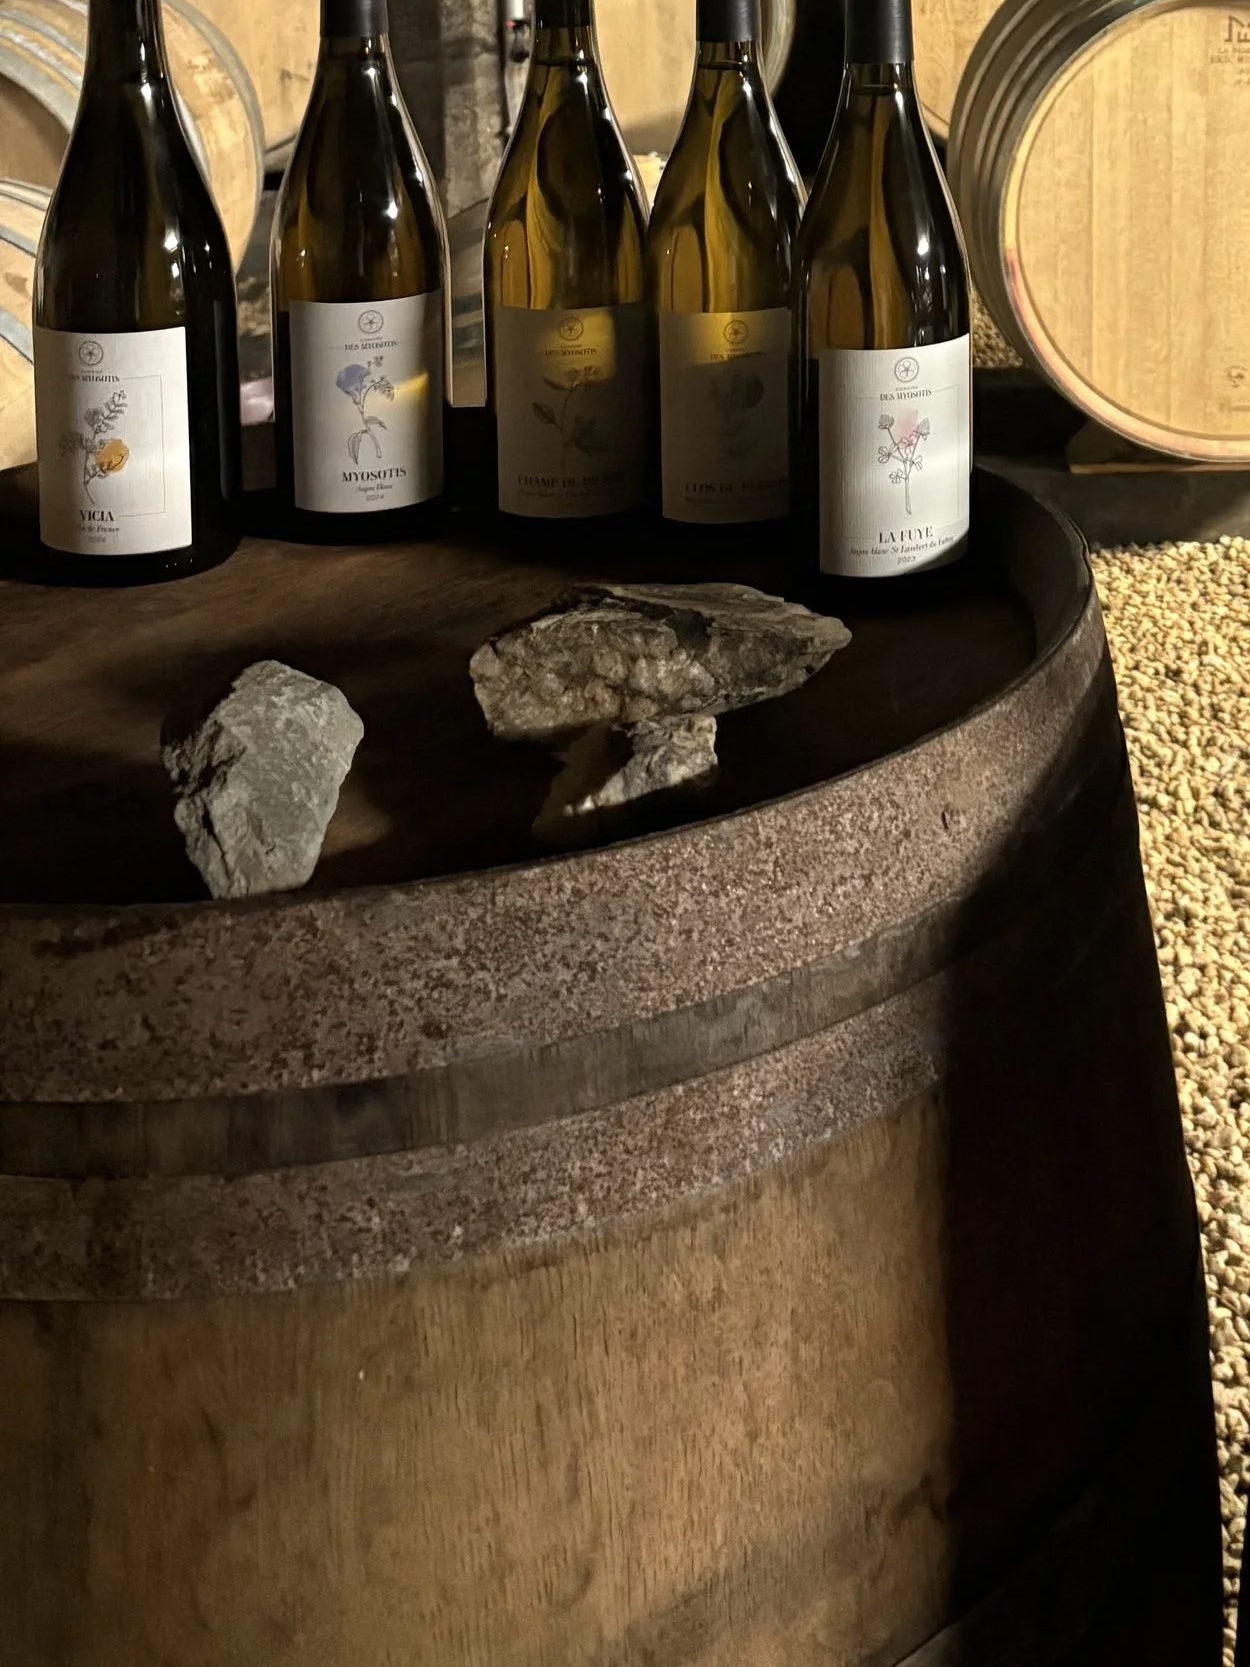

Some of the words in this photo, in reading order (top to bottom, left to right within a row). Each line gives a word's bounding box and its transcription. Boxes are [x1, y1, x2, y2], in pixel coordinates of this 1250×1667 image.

[896, 389, 933, 400] MYOSOTIS
[342, 466, 407, 483] MYOSOTIS
[79, 509, 115, 522] VICIA
[879, 531, 896, 544] LA
[900, 525, 933, 542] FUYE
